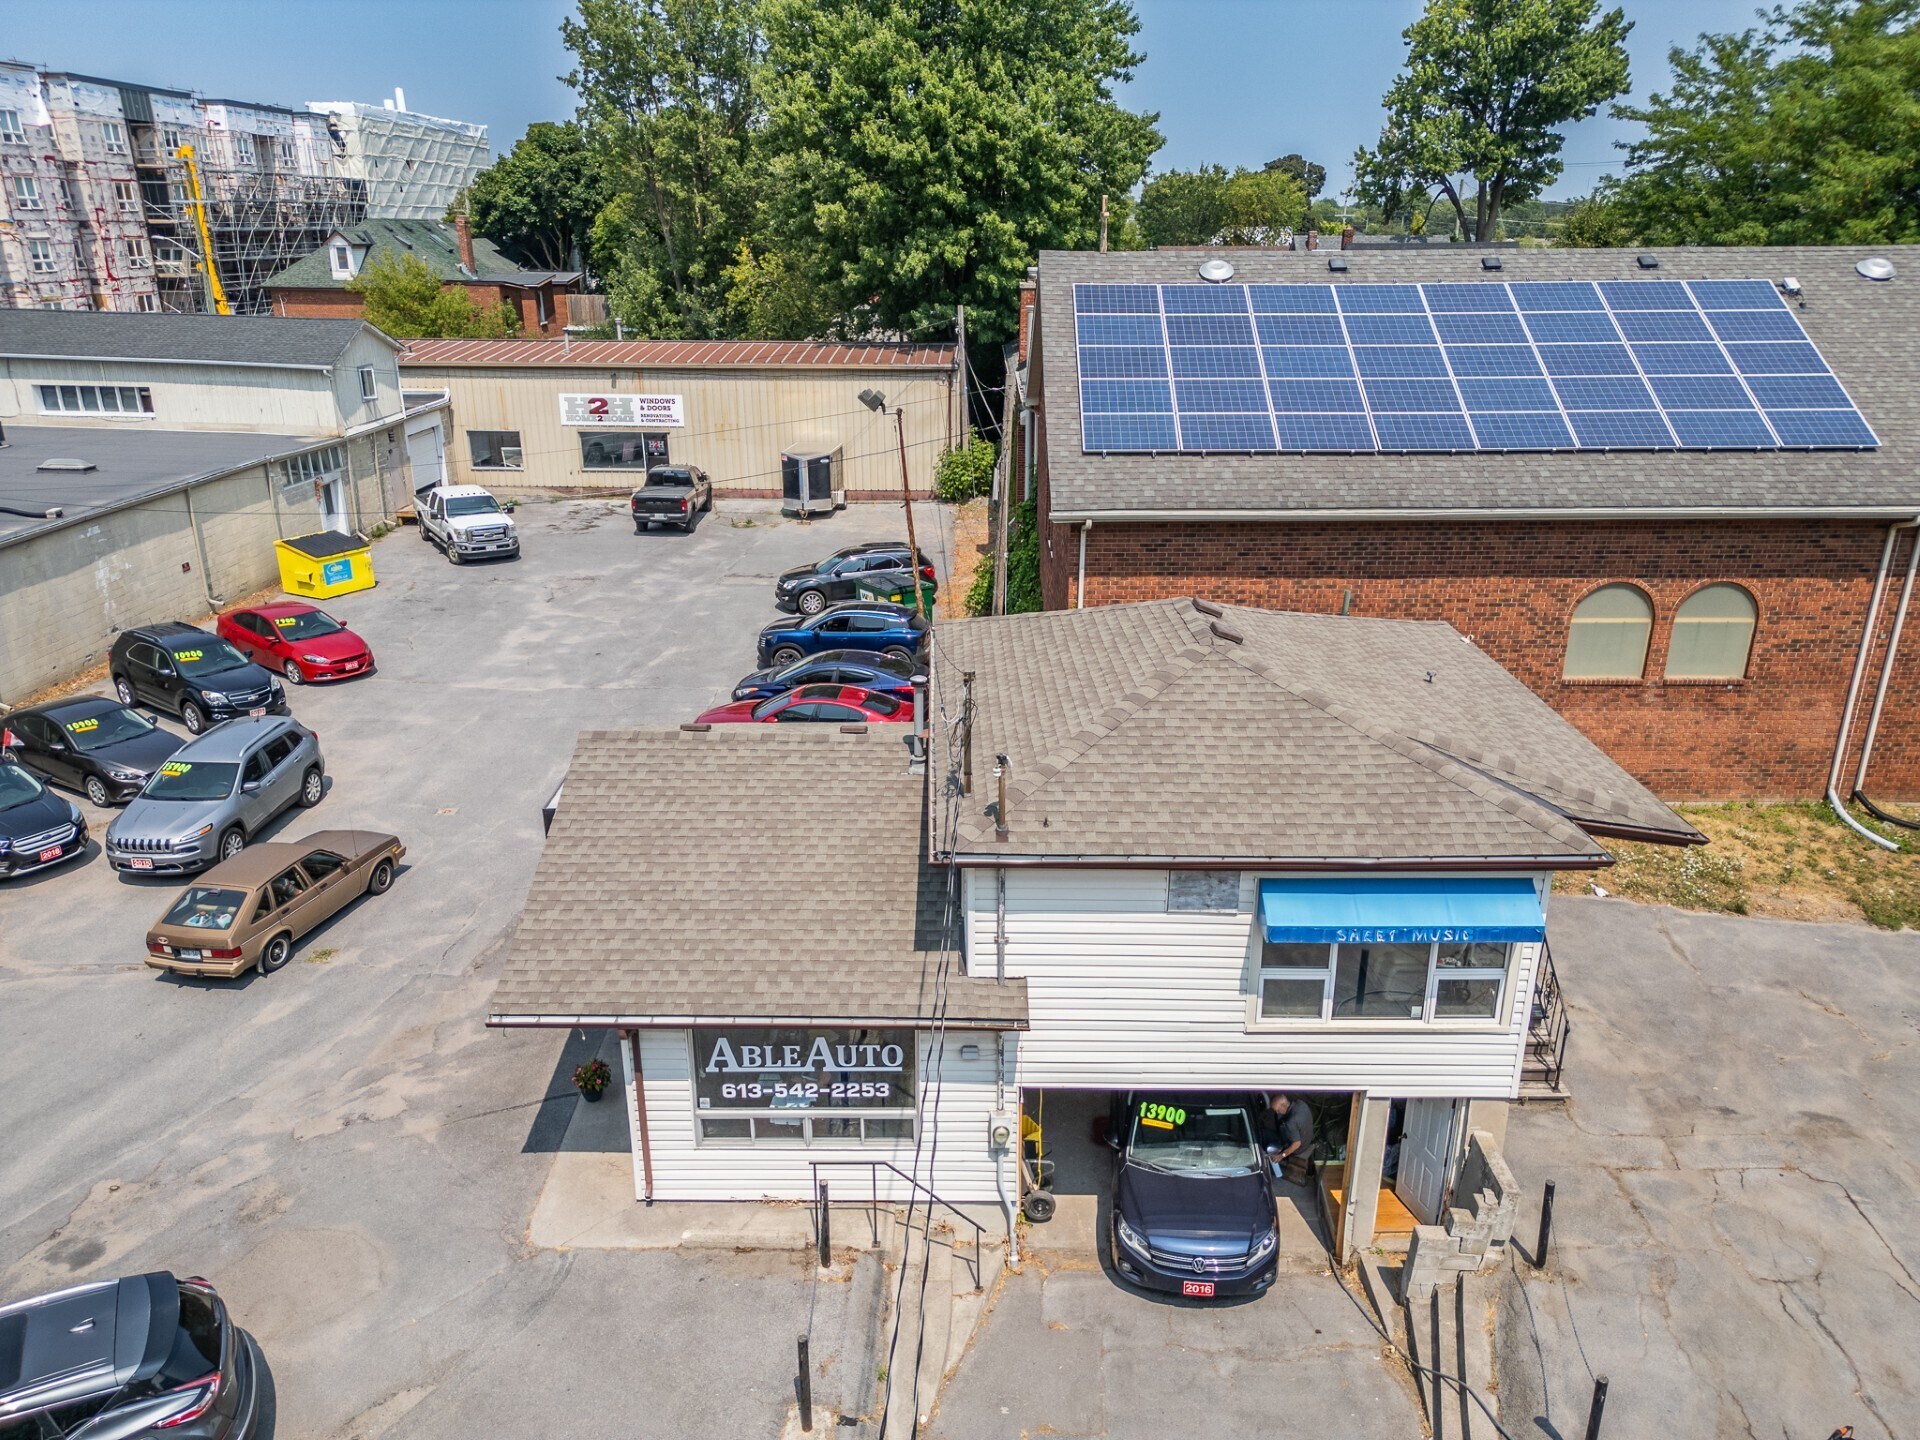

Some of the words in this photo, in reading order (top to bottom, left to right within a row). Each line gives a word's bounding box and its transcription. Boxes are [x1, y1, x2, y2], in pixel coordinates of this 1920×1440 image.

[639, 397, 676, 405] WINDOWS
[274, 617, 296, 625] 7900
[173, 650, 203, 660] 10900
[66, 718, 99, 731] 10900
[162, 761, 192, 773] 15900
[42, 848, 61, 859] 2018
[1412, 929, 1470, 942] MUSIC
[722, 1082, 890, 1099] 613-542-2253
[1140, 1101, 1186, 1126] 13900
[1185, 1284, 1212, 1294] 2016
